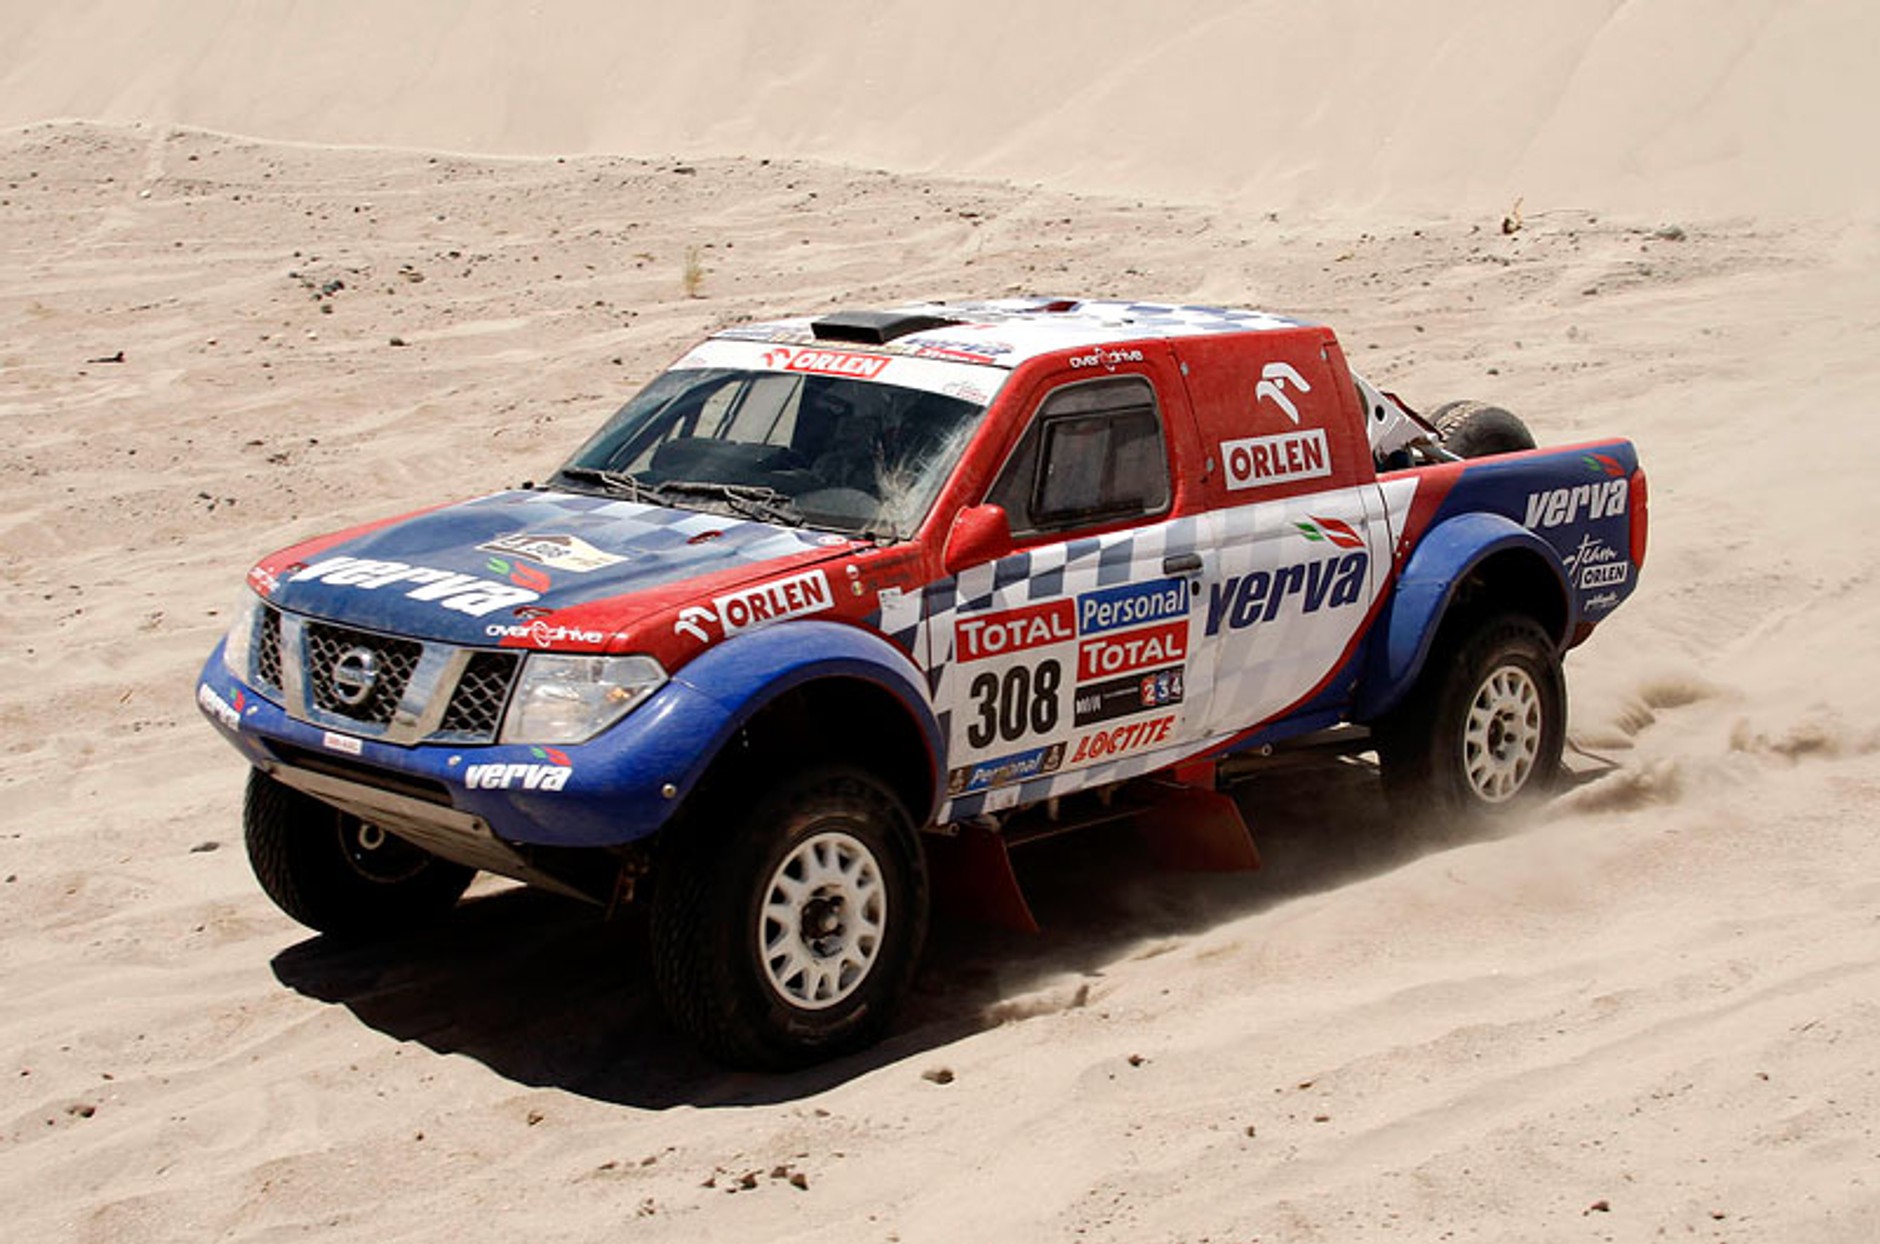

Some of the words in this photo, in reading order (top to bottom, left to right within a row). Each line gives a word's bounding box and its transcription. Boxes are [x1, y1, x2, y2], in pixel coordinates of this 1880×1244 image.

[793, 350, 885, 376] ORLEN
[1229, 436, 1324, 482] ORLEN
[1525, 478, 1628, 529] verva
[289, 556, 540, 617] verva
[1204, 551, 1369, 637] verva
[1584, 564, 1625, 584] ORLEN
[726, 575, 826, 628] ORLEN
[1083, 580, 1186, 630] Personal
[967, 658, 1062, 750] 308
[1071, 714, 1176, 763] LOCTITE
[464, 763, 573, 792] verva
